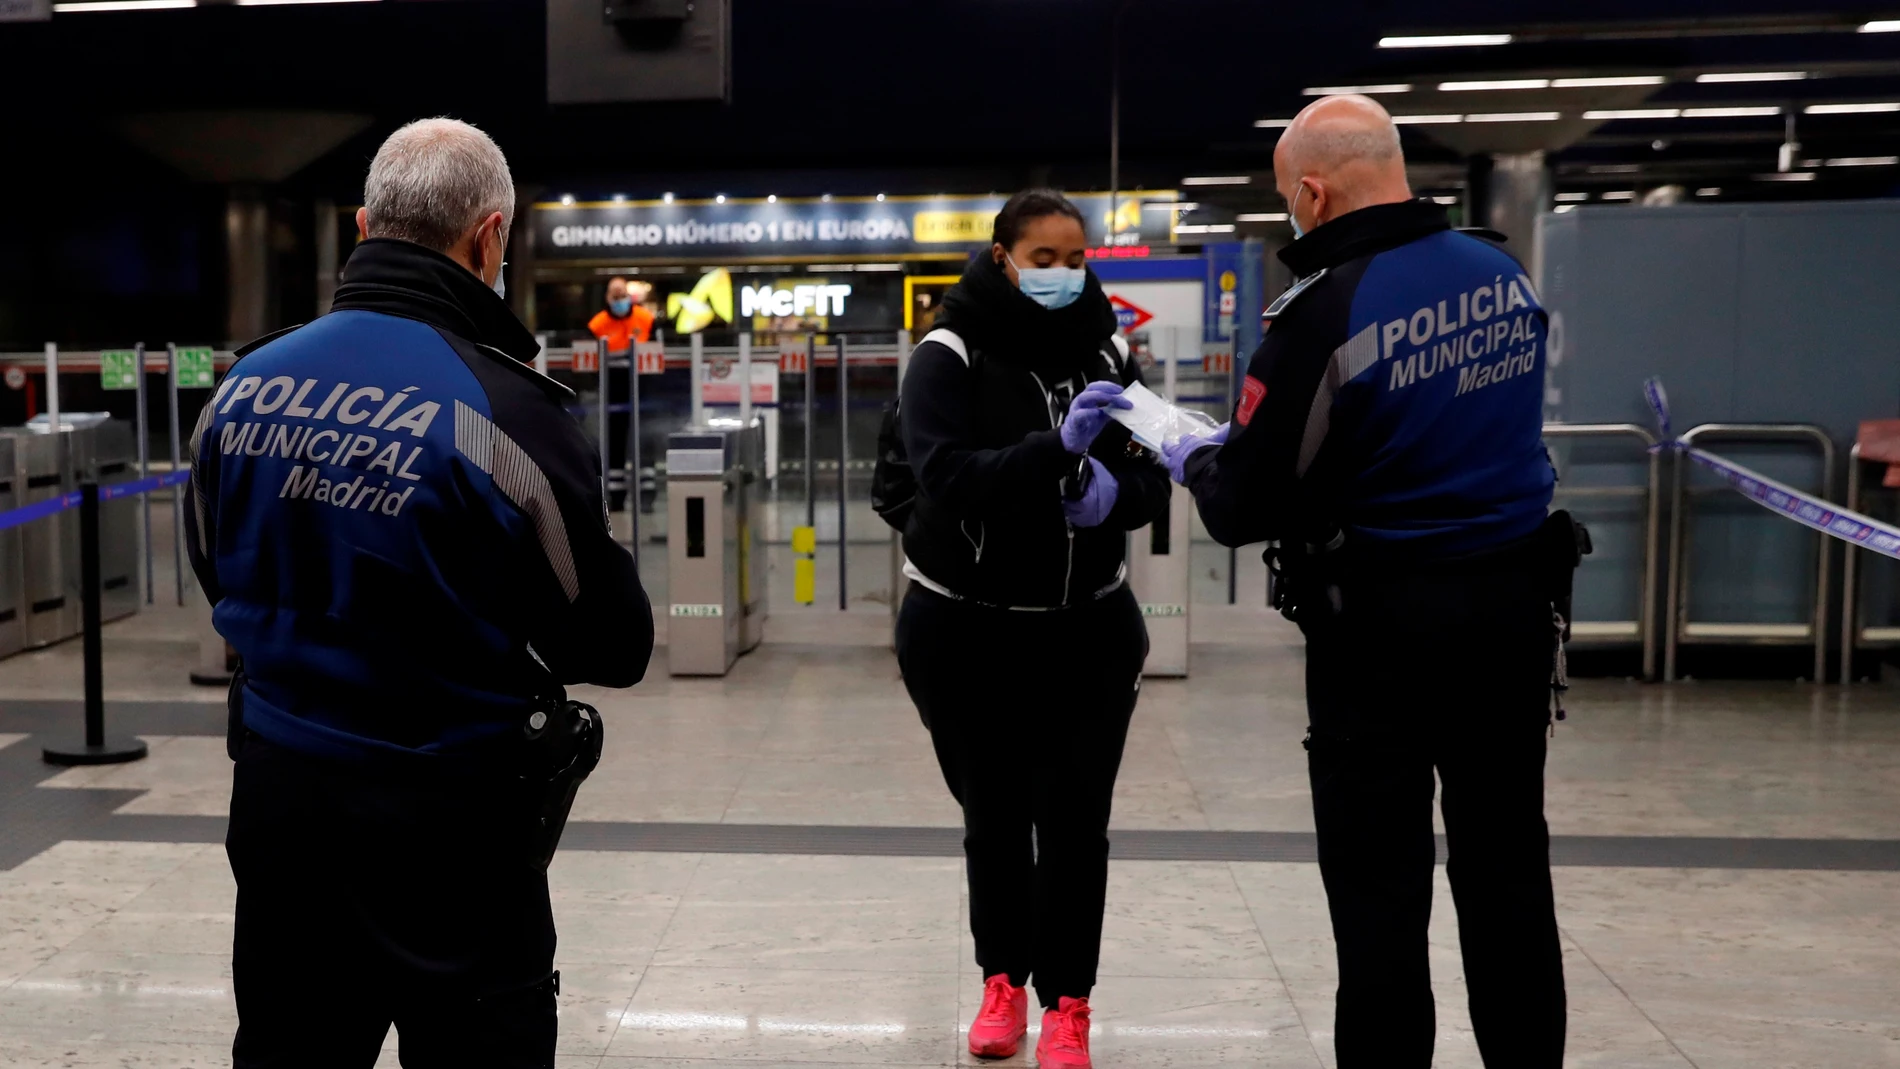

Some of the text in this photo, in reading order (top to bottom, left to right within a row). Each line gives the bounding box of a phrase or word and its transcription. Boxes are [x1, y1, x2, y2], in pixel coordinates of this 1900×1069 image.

[552, 225, 662, 247] GIMNASIO
[666, 219, 763, 245] NÚMERO
[767, 220, 778, 242] 1
[782, 220, 814, 242] EN
[818, 219, 909, 241] EUROPA
[741, 284, 851, 317] McFIT
[1383, 274, 1528, 359] POLICÍA
[1389, 313, 1536, 391] MUNICIPAL
[1454, 342, 1537, 397] Madrid
[219, 375, 441, 438] POLICÍA
[220, 421, 423, 481] MUNICIPAL
[279, 465, 415, 517] Madrid
[674, 605, 719, 617] SALIDA
[1140, 605, 1183, 617] ALIDA
